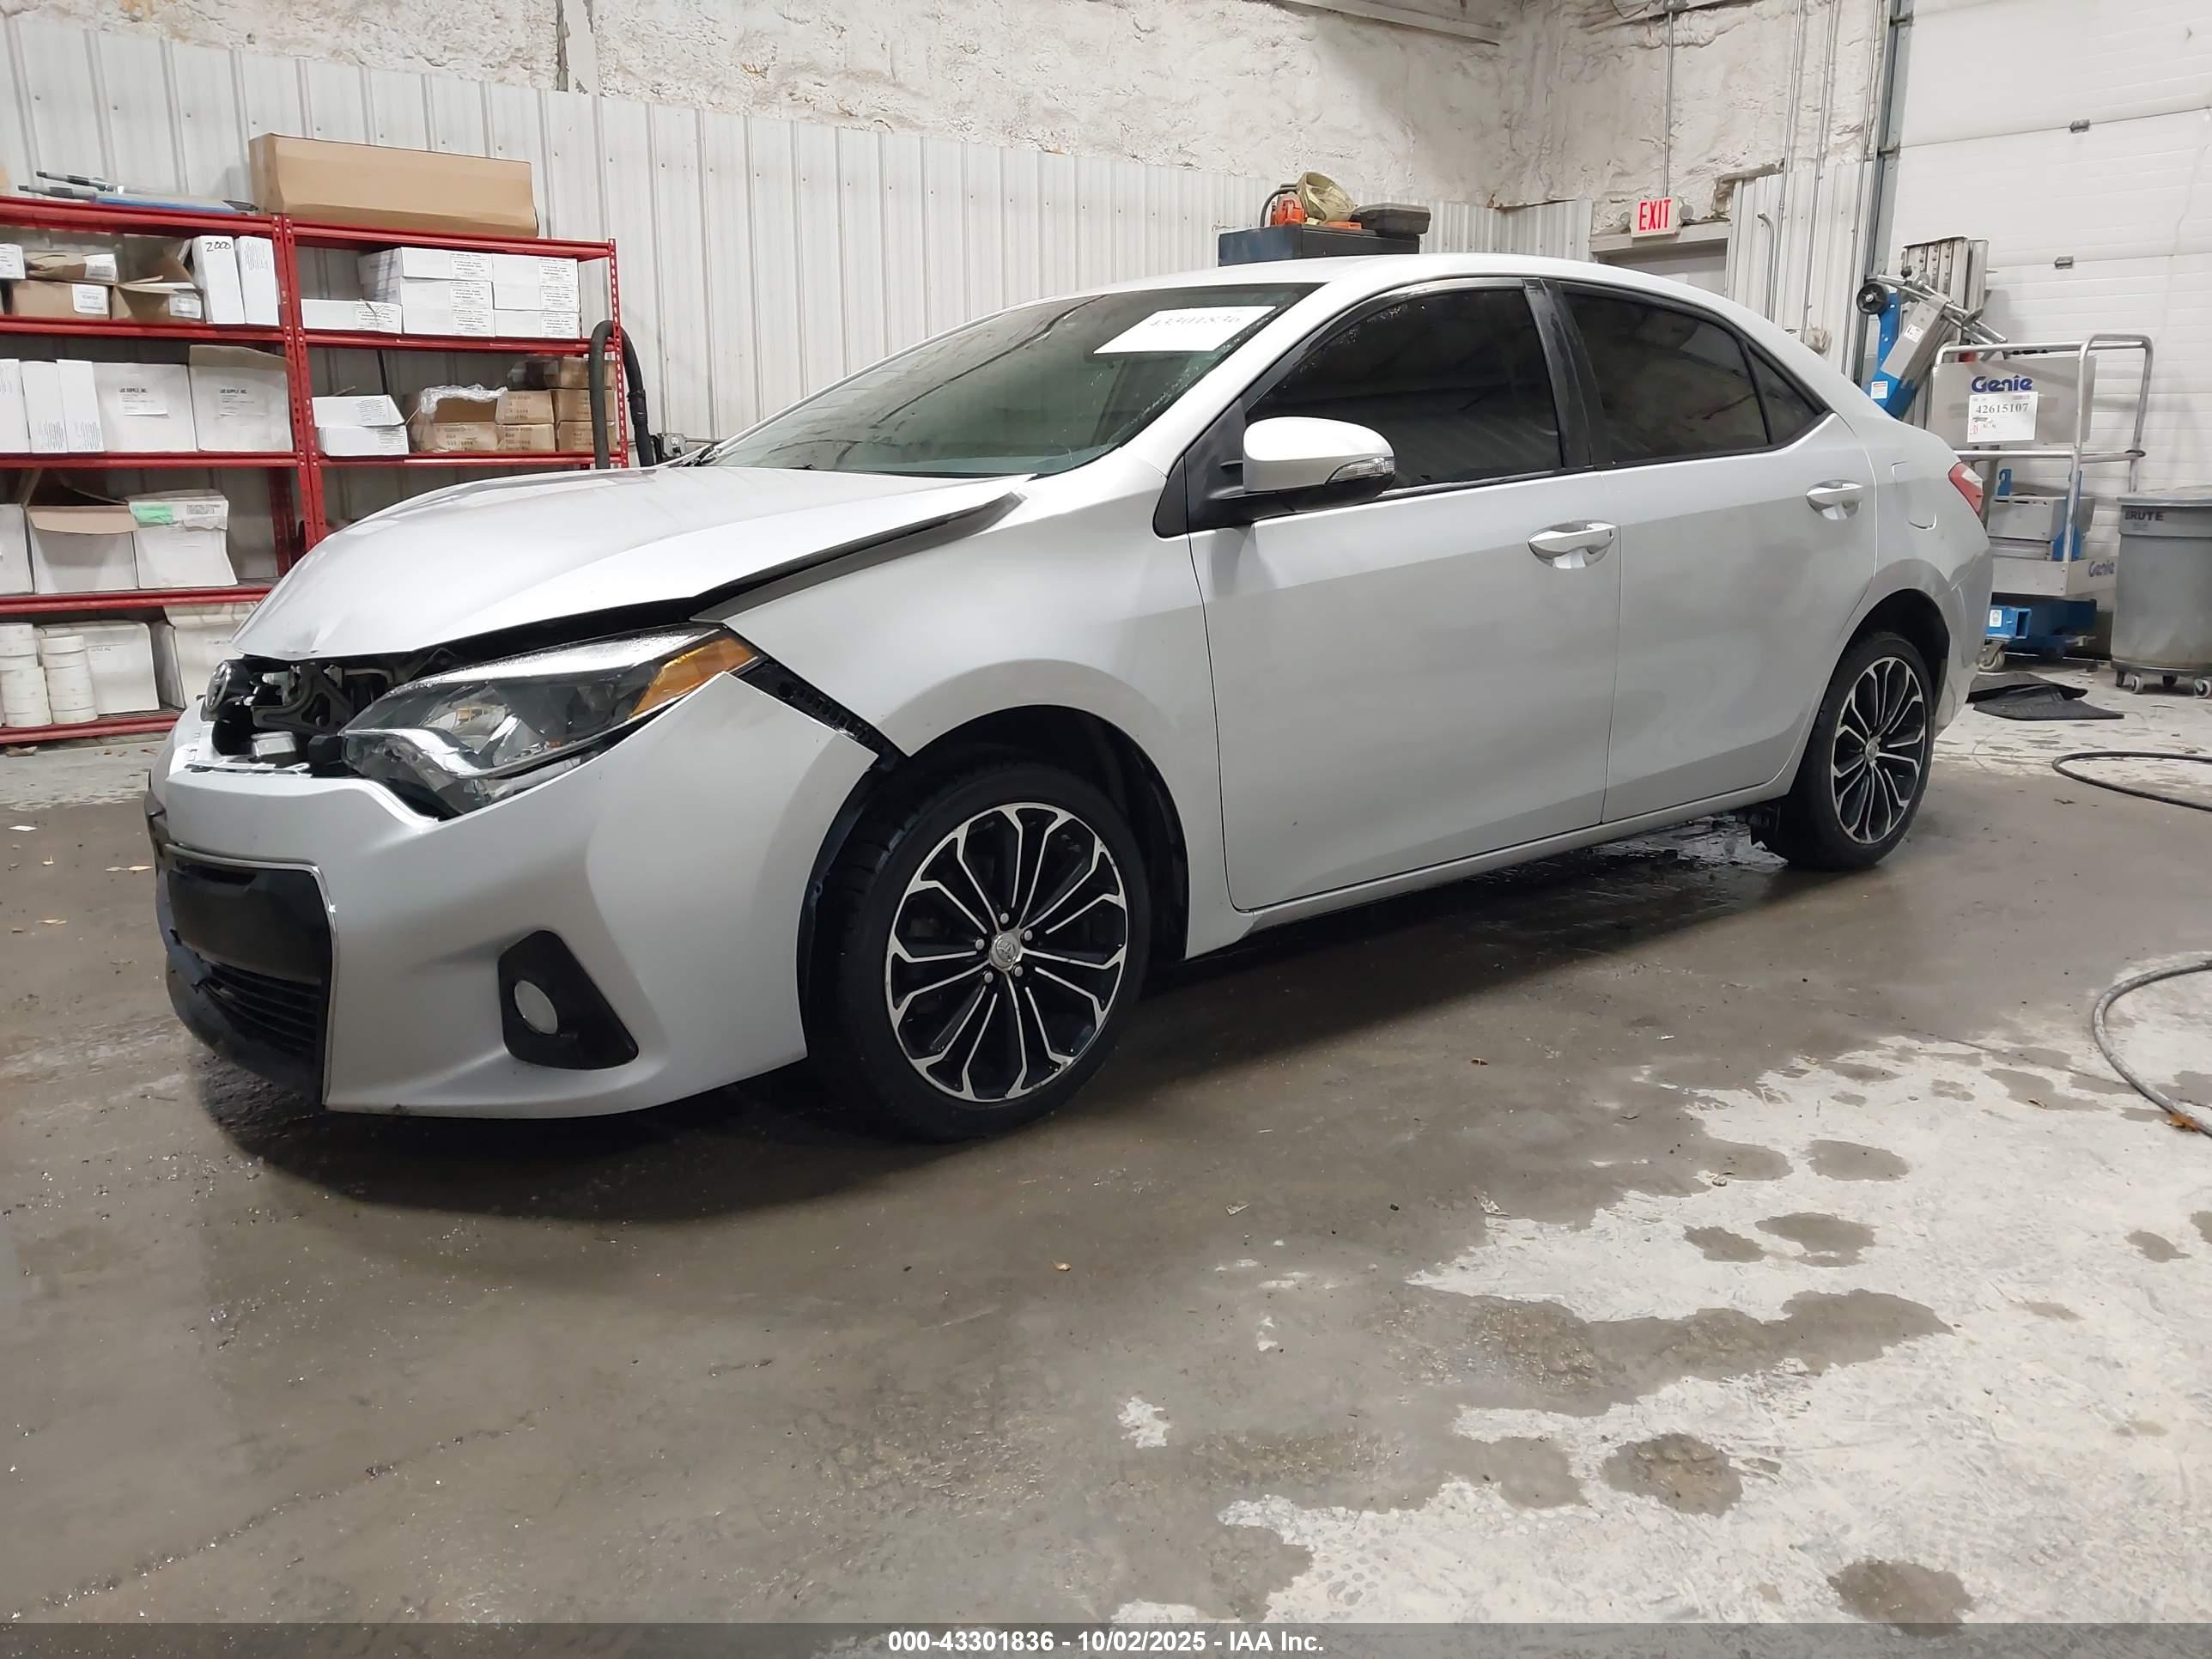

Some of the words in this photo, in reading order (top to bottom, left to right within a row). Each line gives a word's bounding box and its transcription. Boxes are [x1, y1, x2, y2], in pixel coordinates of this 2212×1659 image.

[1638, 198, 1672, 231] EXIT
[205, 241, 232, 252] 2000
[1971, 374, 2033, 393] Genie
[1976, 403, 2029, 414] 42615107
